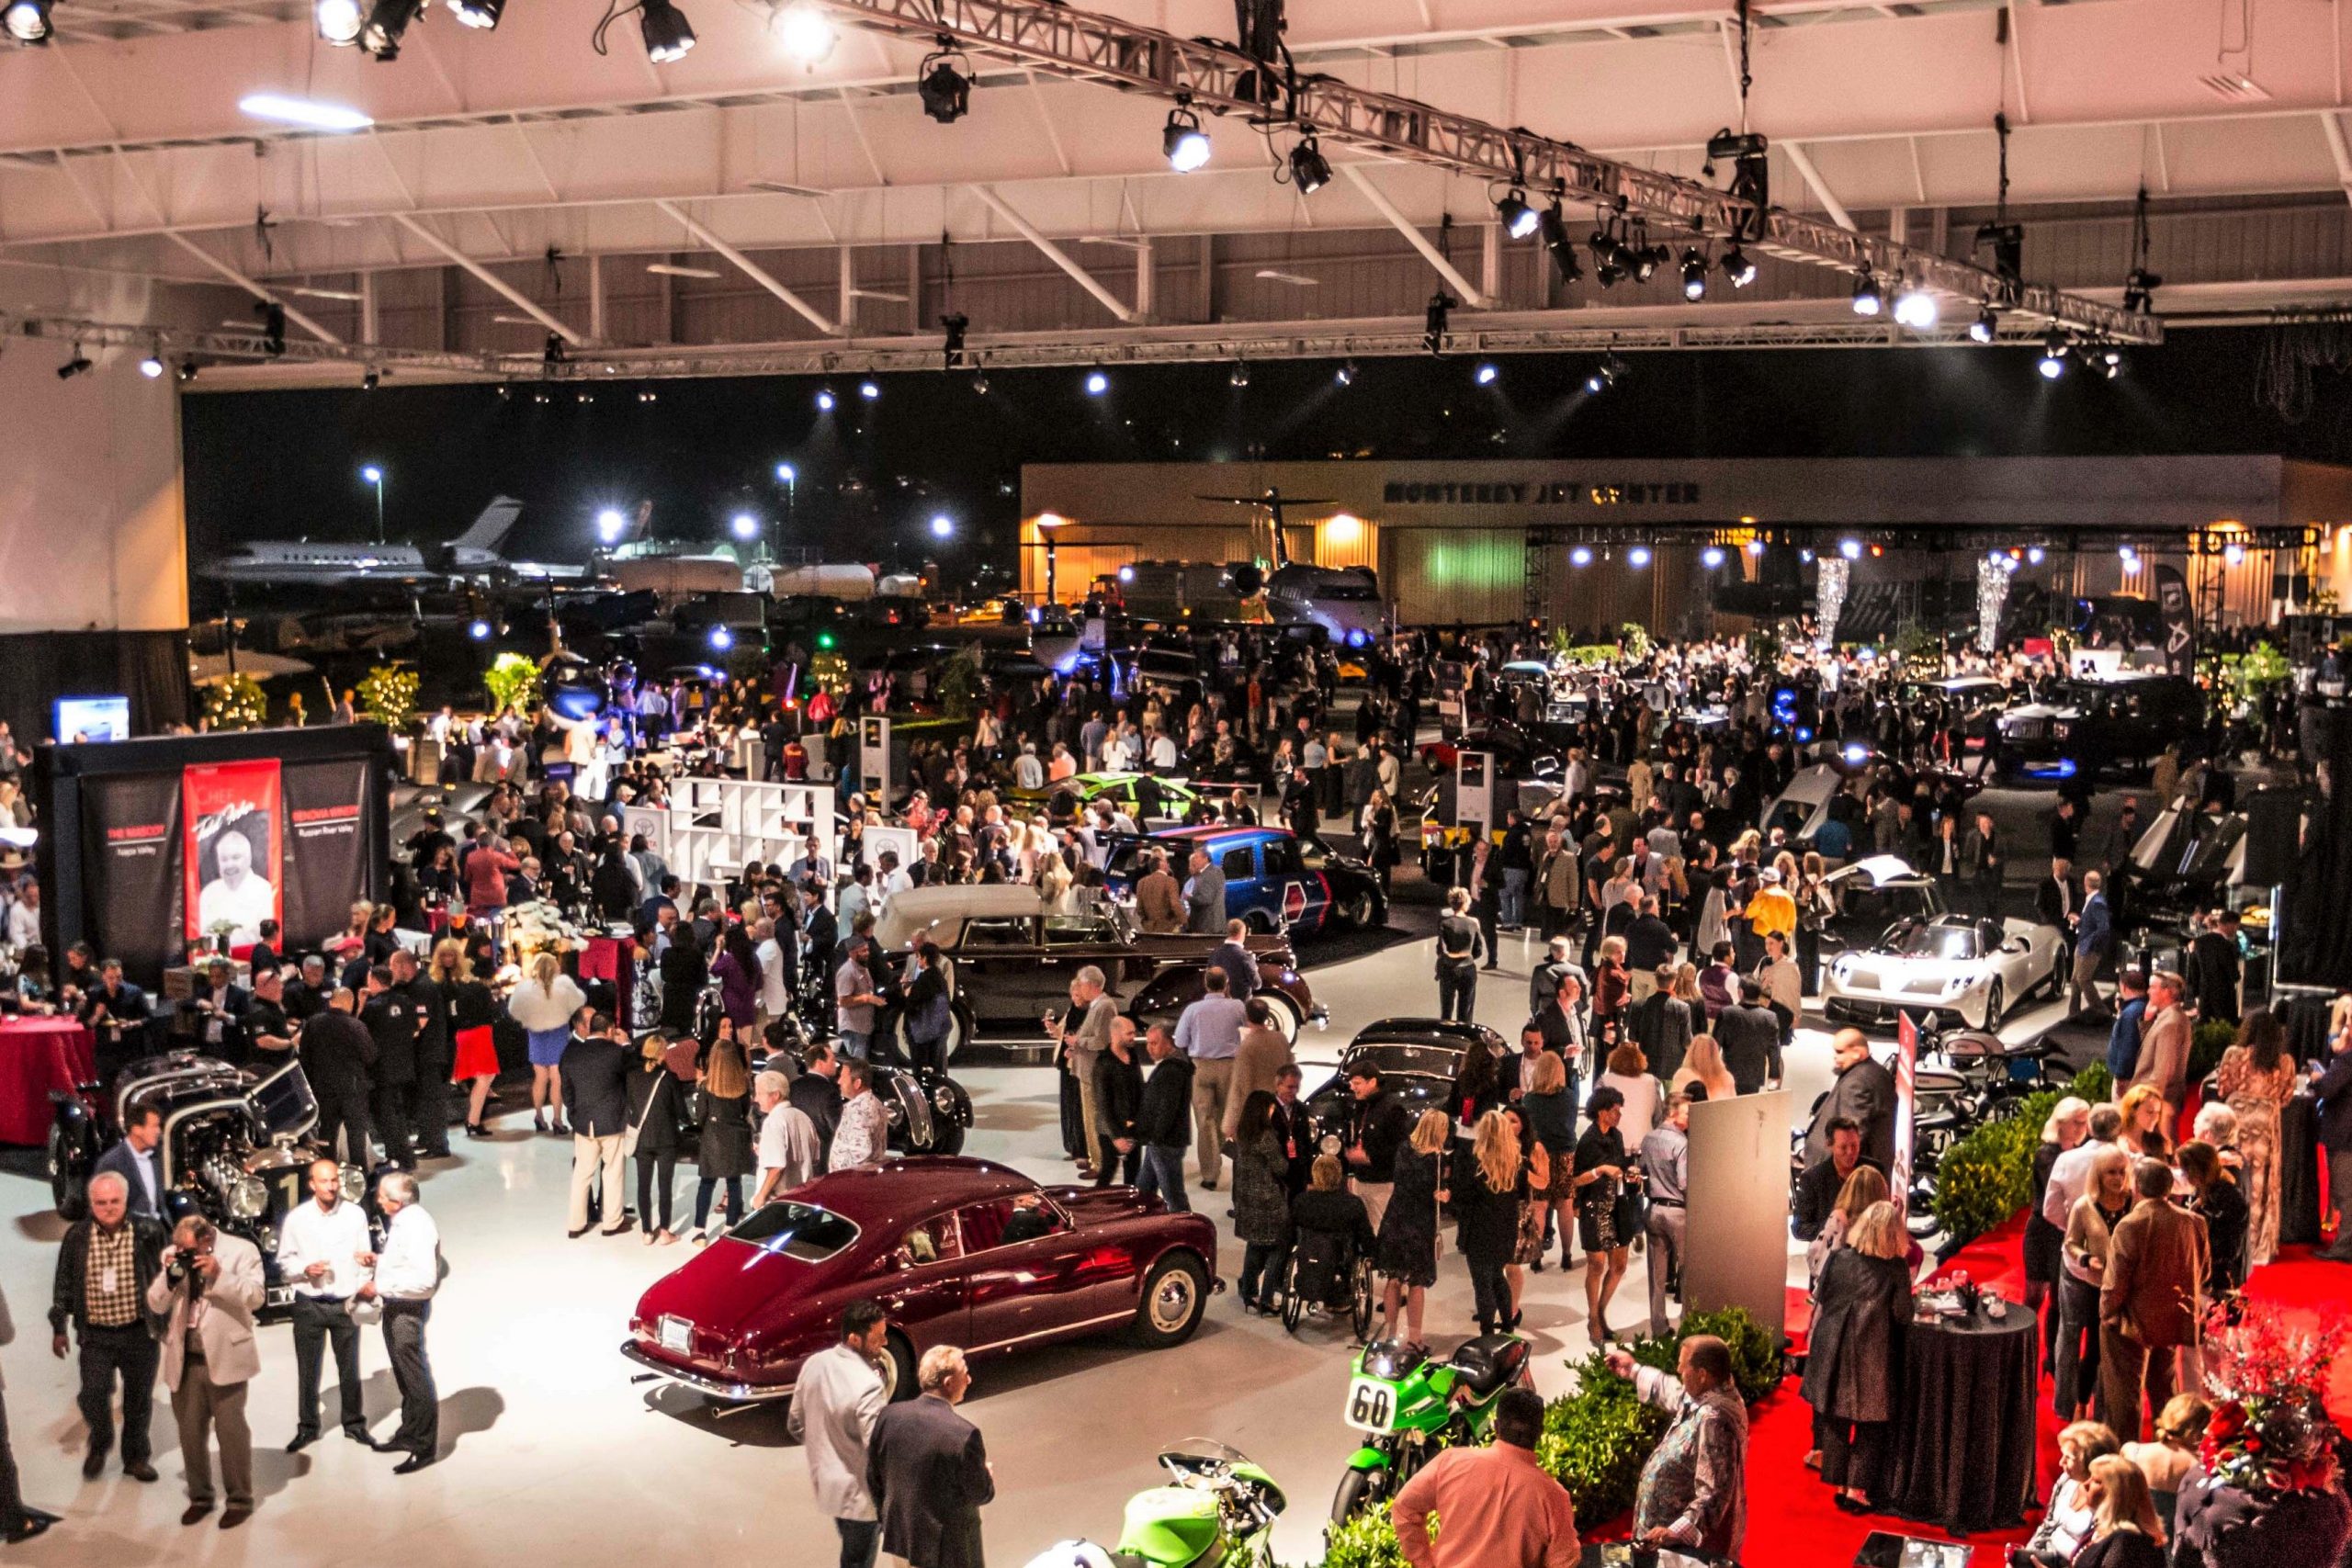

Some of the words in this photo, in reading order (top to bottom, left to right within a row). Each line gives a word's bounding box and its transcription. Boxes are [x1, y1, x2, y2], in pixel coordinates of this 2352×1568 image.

[1384, 482, 1525, 503] MONTEREY
[1536, 482, 1582, 503] JET
[278, 1172, 299, 1211] 1
[1352, 1384, 1389, 1428] 60
